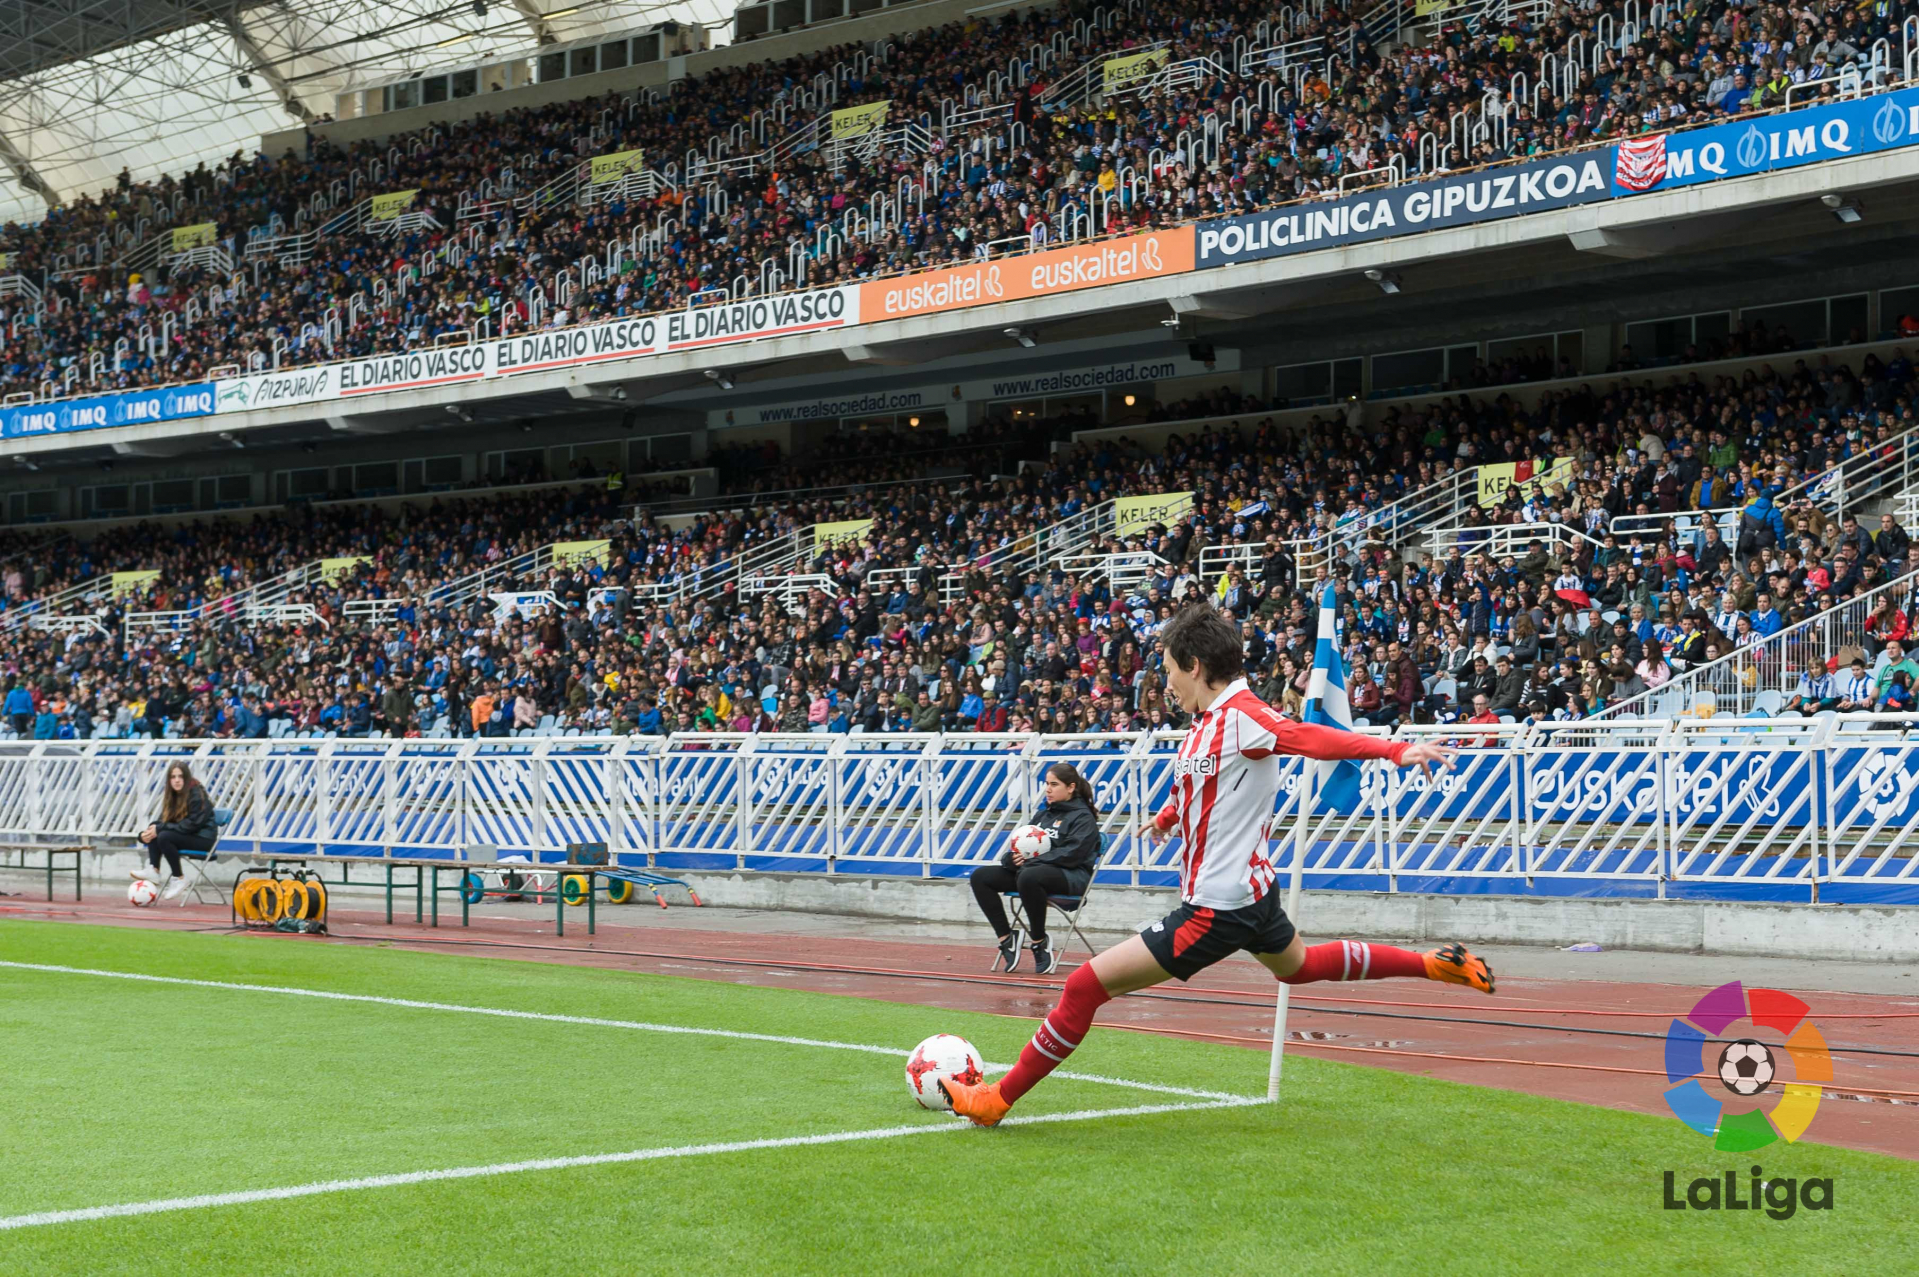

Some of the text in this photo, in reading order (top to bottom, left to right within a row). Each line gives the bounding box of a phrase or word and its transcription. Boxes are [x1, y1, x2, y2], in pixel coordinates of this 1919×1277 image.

[1769, 119, 1852, 160] IMQ
[1664, 142, 1728, 179] MQ
[1201, 159, 1605, 259] POLICLINICA GIPUZKOA
[1031, 242, 1138, 289] euskaltel
[885, 270, 981, 313] euskaltel
[669, 290, 844, 341] EL DIARIO VASCO
[497, 320, 655, 367] EL DIARIO VASCO
[340, 347, 485, 389] EL DIARIO VASCO
[993, 362, 1175, 396] www.realsociedad.com
[22, 412, 57, 432] IMQ
[72, 406, 107, 426] IMQ
[127, 399, 161, 420] IMQ
[177, 392, 212, 414] IMQ
[760, 392, 922, 422] www.realsociedad.com
[1532, 758, 1729, 813] euskaltel
